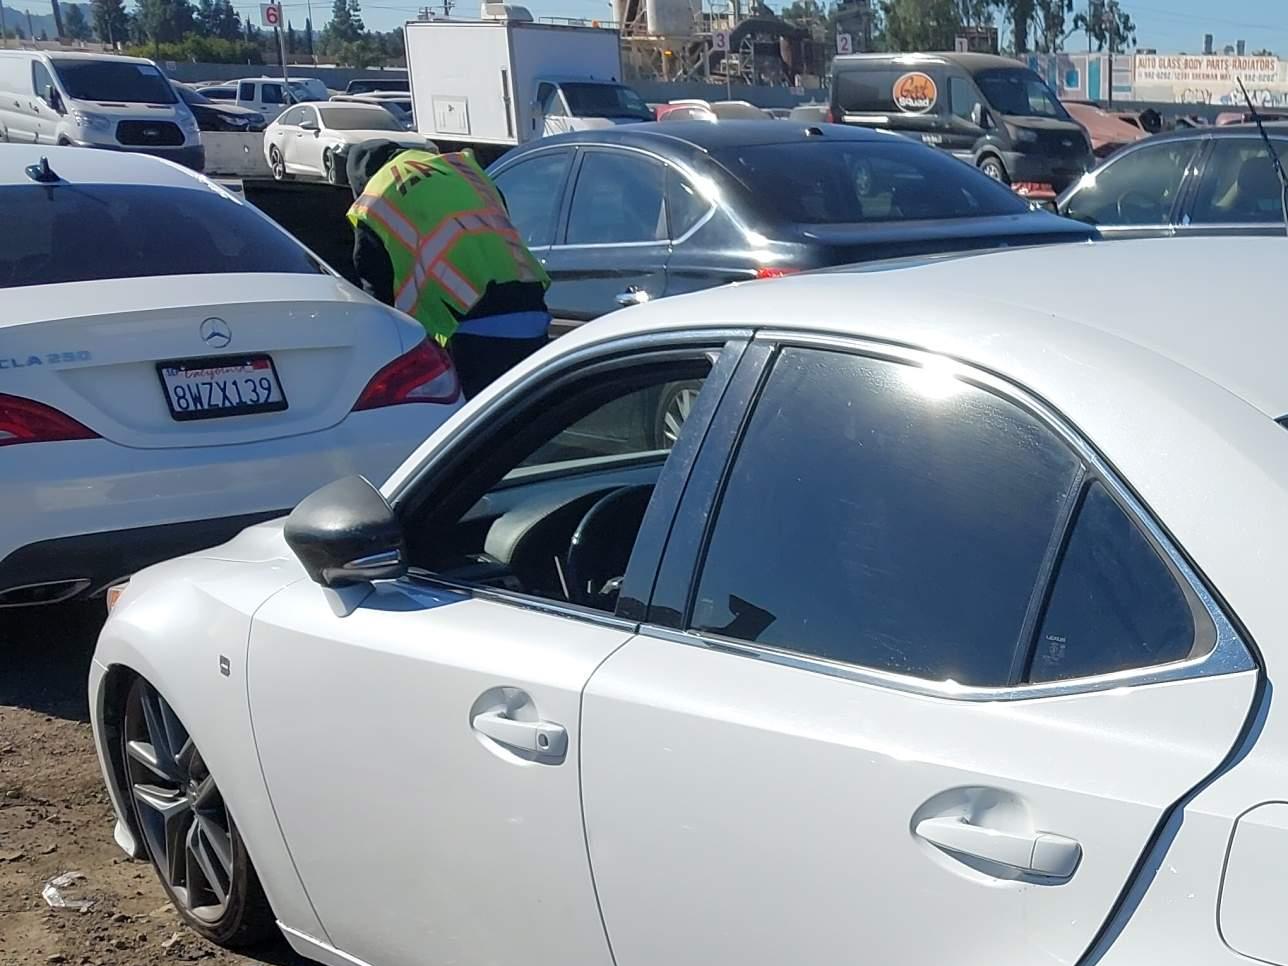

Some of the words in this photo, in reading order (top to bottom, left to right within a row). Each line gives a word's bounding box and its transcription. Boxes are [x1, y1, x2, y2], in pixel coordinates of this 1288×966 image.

[266, 7, 277, 24] 6
[716, 33, 725, 48] 3
[840, 37, 849, 51] 2
[1138, 58, 1156, 69] AUTO
[1158, 58, 1181, 69] GLASS
[1184, 59, 1202, 69] BODY
[1206, 59, 1229, 71] PARTS
[1232, 59, 1275, 71] RADIATORS
[900, 77, 928, 99] Geek
[0, 355, 42, 369] CLA
[47, 350, 91, 364] 250
[173, 377, 272, 410] 8WZX139
